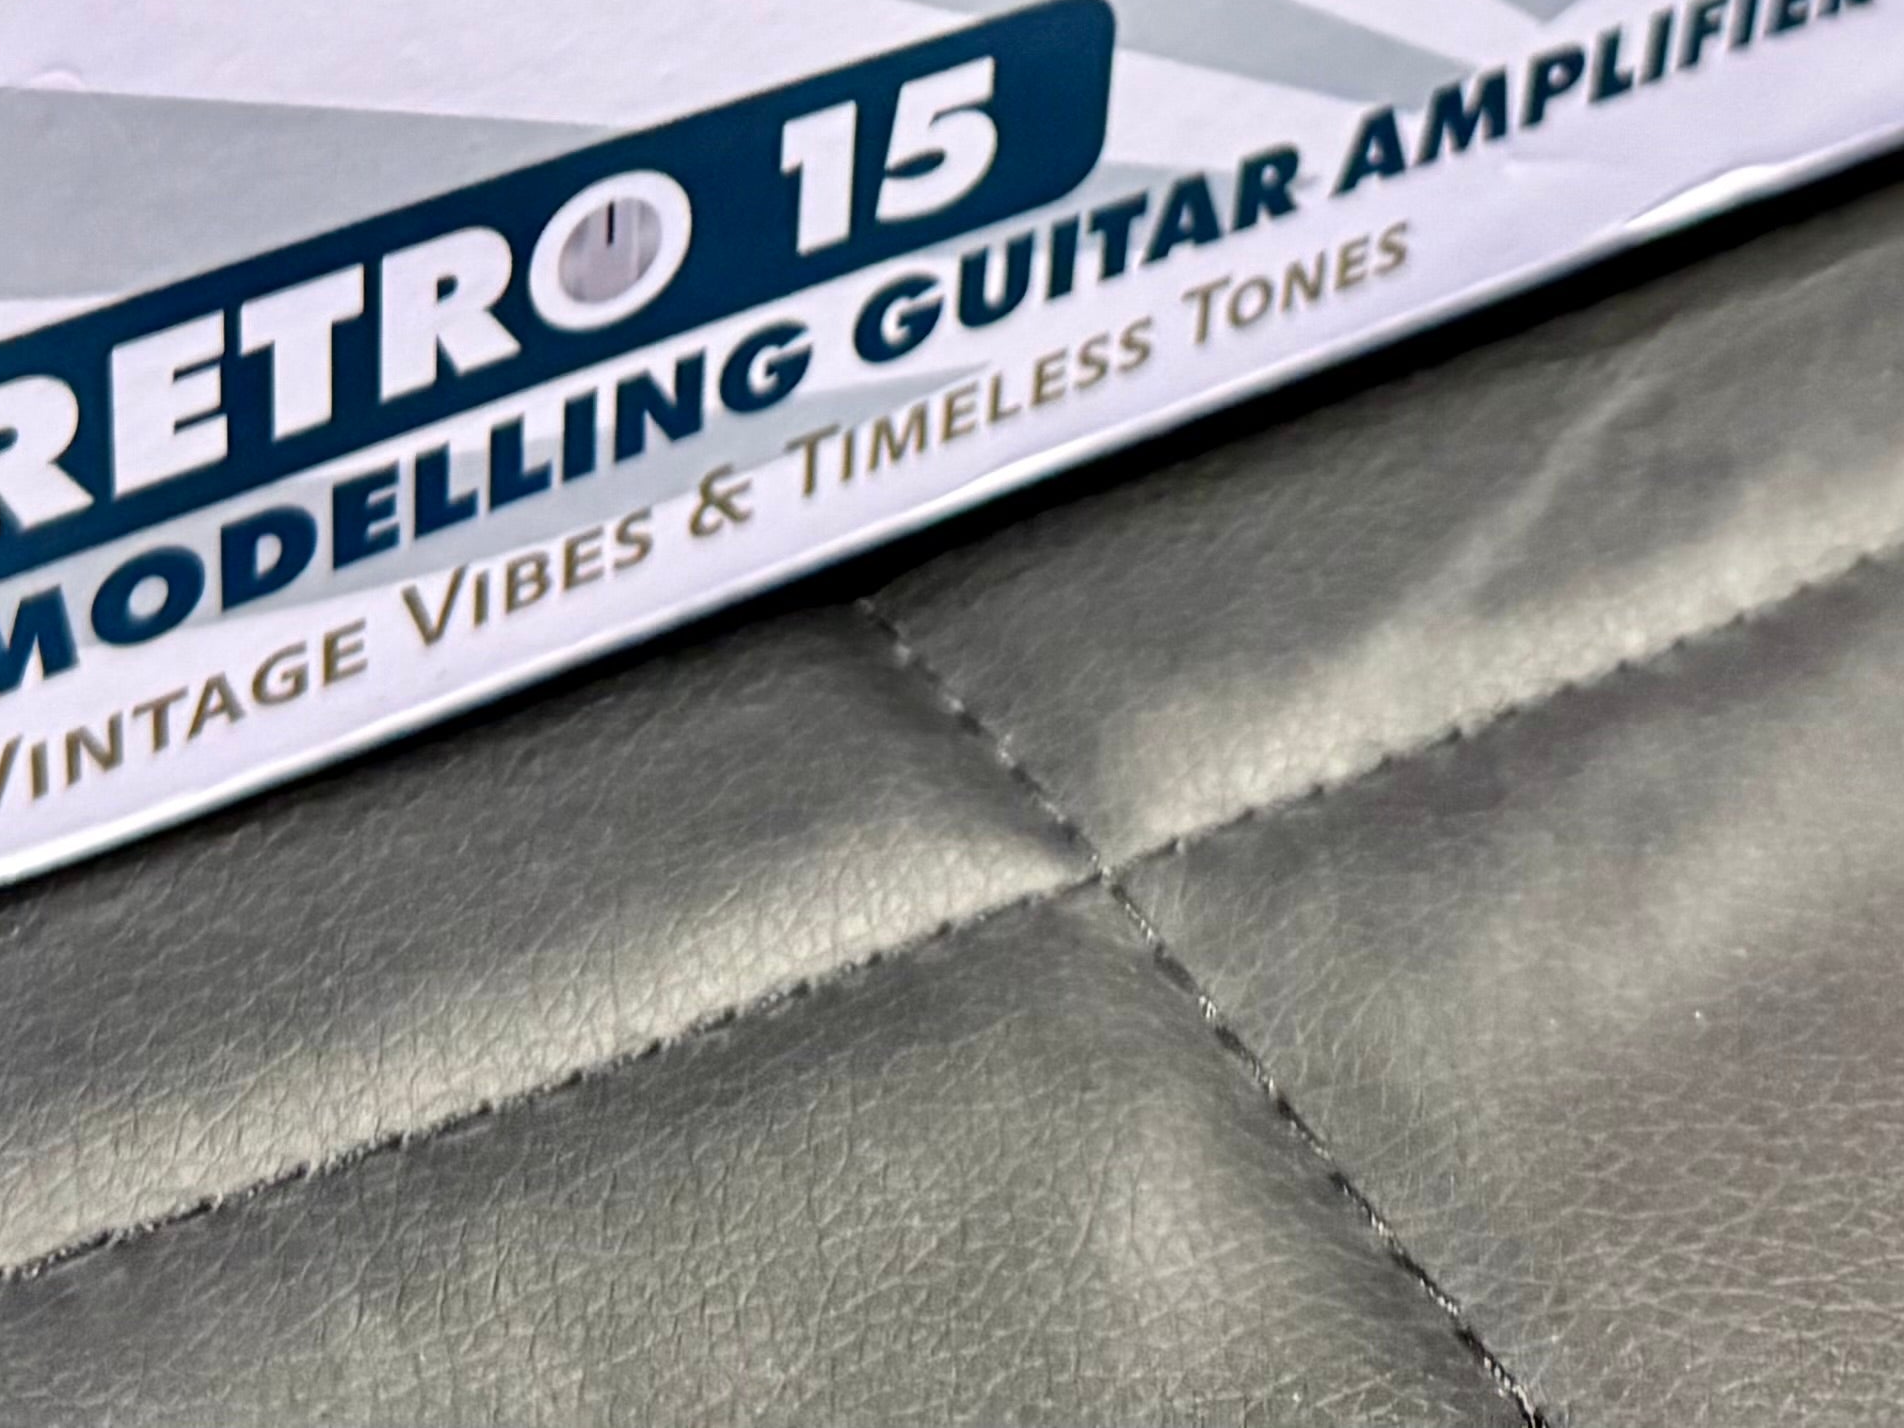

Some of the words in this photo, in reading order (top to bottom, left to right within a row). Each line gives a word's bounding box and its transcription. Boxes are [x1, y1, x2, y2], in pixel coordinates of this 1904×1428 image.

[779, 55, 999, 258] 15
[853, 142, 1304, 366] GUITAR
[401, 507, 654, 650] VIBES
[687, 462, 755, 540] &
[786, 315, 1154, 502] TIMELESS
[1182, 220, 1414, 347] TONES
